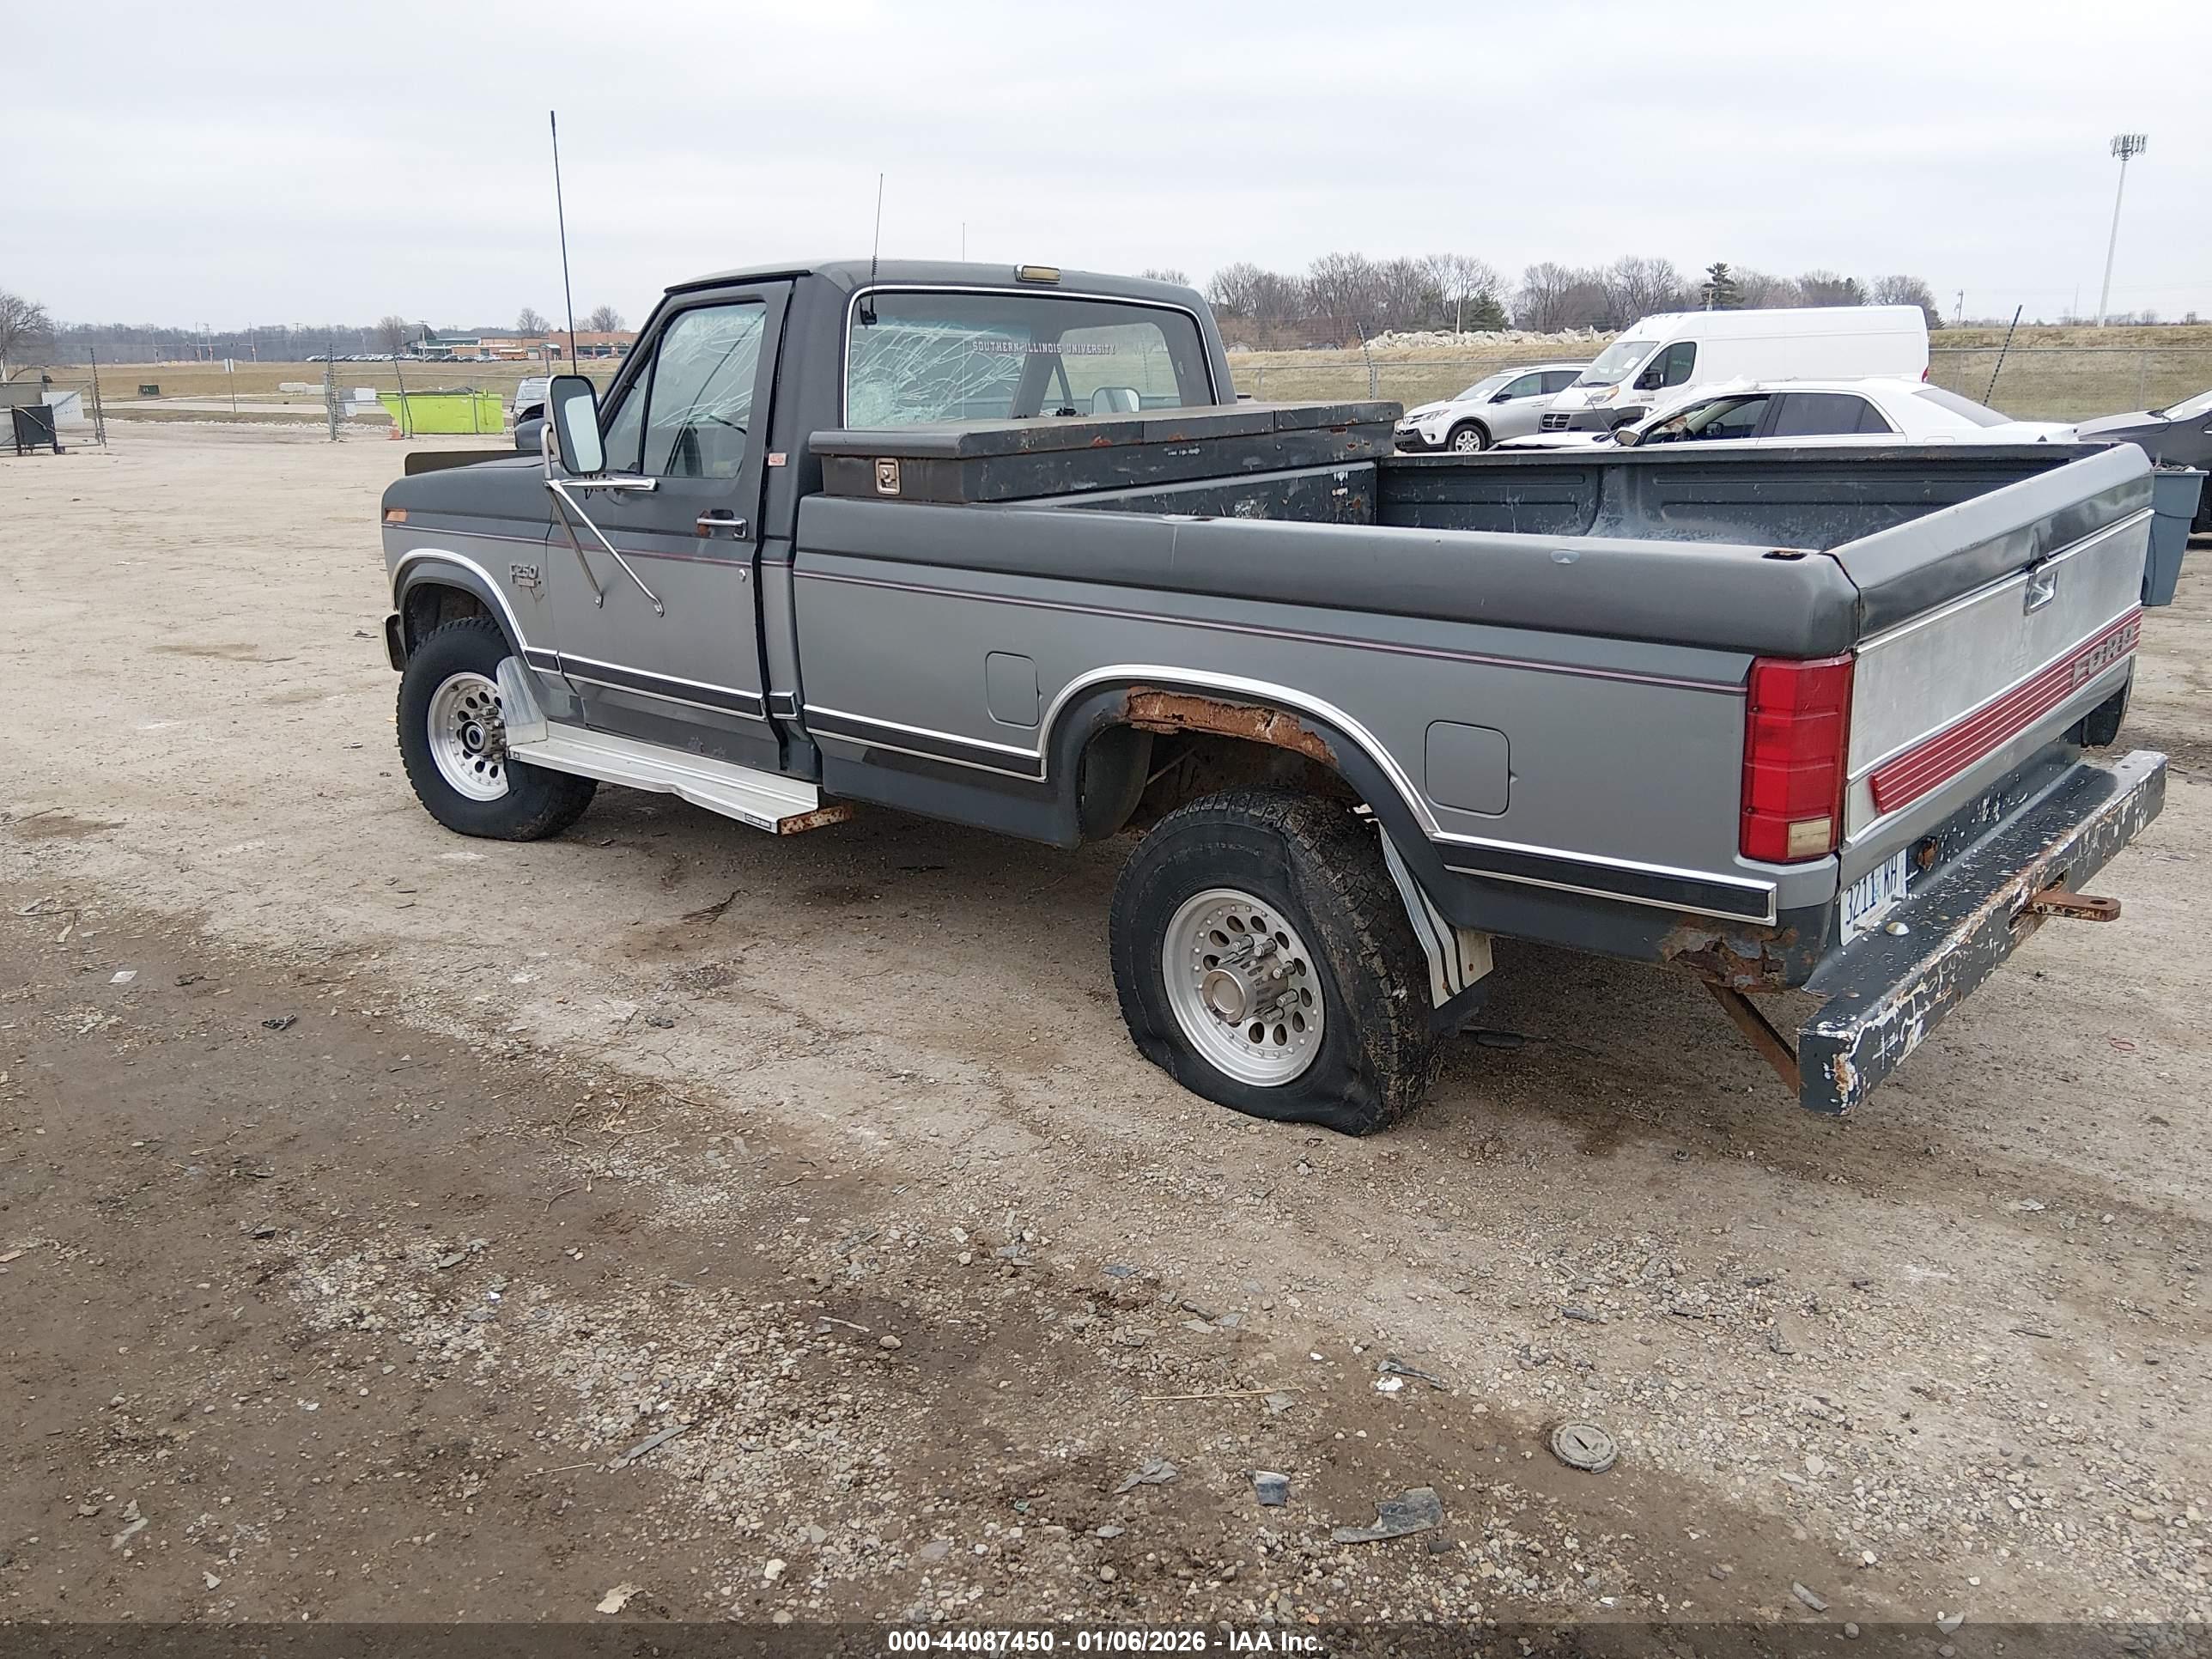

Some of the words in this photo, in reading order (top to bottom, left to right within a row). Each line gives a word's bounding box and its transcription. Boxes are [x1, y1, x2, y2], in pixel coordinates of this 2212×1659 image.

[972, 341, 1020, 352] SOUTHERN
[1024, 343, 1062, 353] ILLINOIS
[1067, 343, 1116, 355] UNIVERSITY
[2074, 624, 2135, 687] FORD
